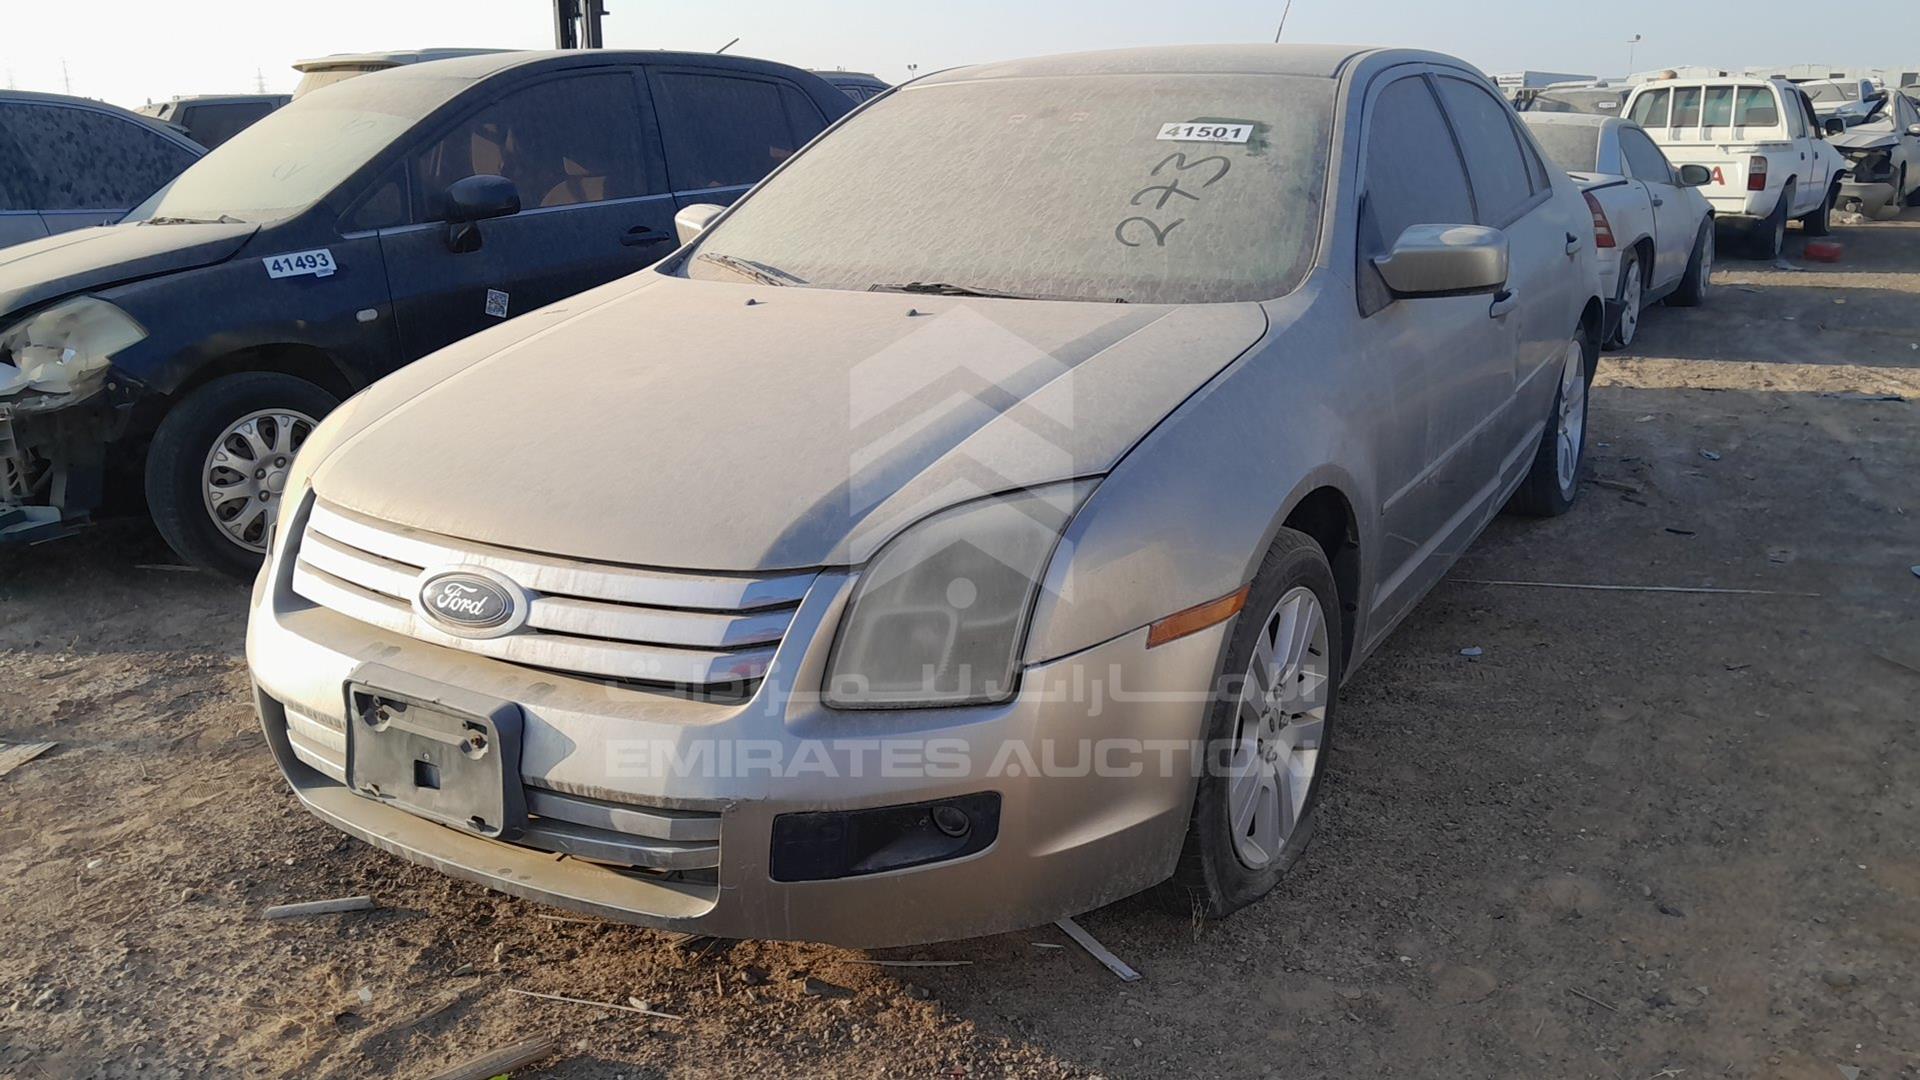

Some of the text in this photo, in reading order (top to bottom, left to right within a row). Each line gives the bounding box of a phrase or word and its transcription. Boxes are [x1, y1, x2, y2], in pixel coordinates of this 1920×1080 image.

[1164, 126, 1242, 139] 41501
[1115, 152, 1231, 247] 273
[272, 253, 330, 273] 41493
[436, 582, 488, 615] Ford
